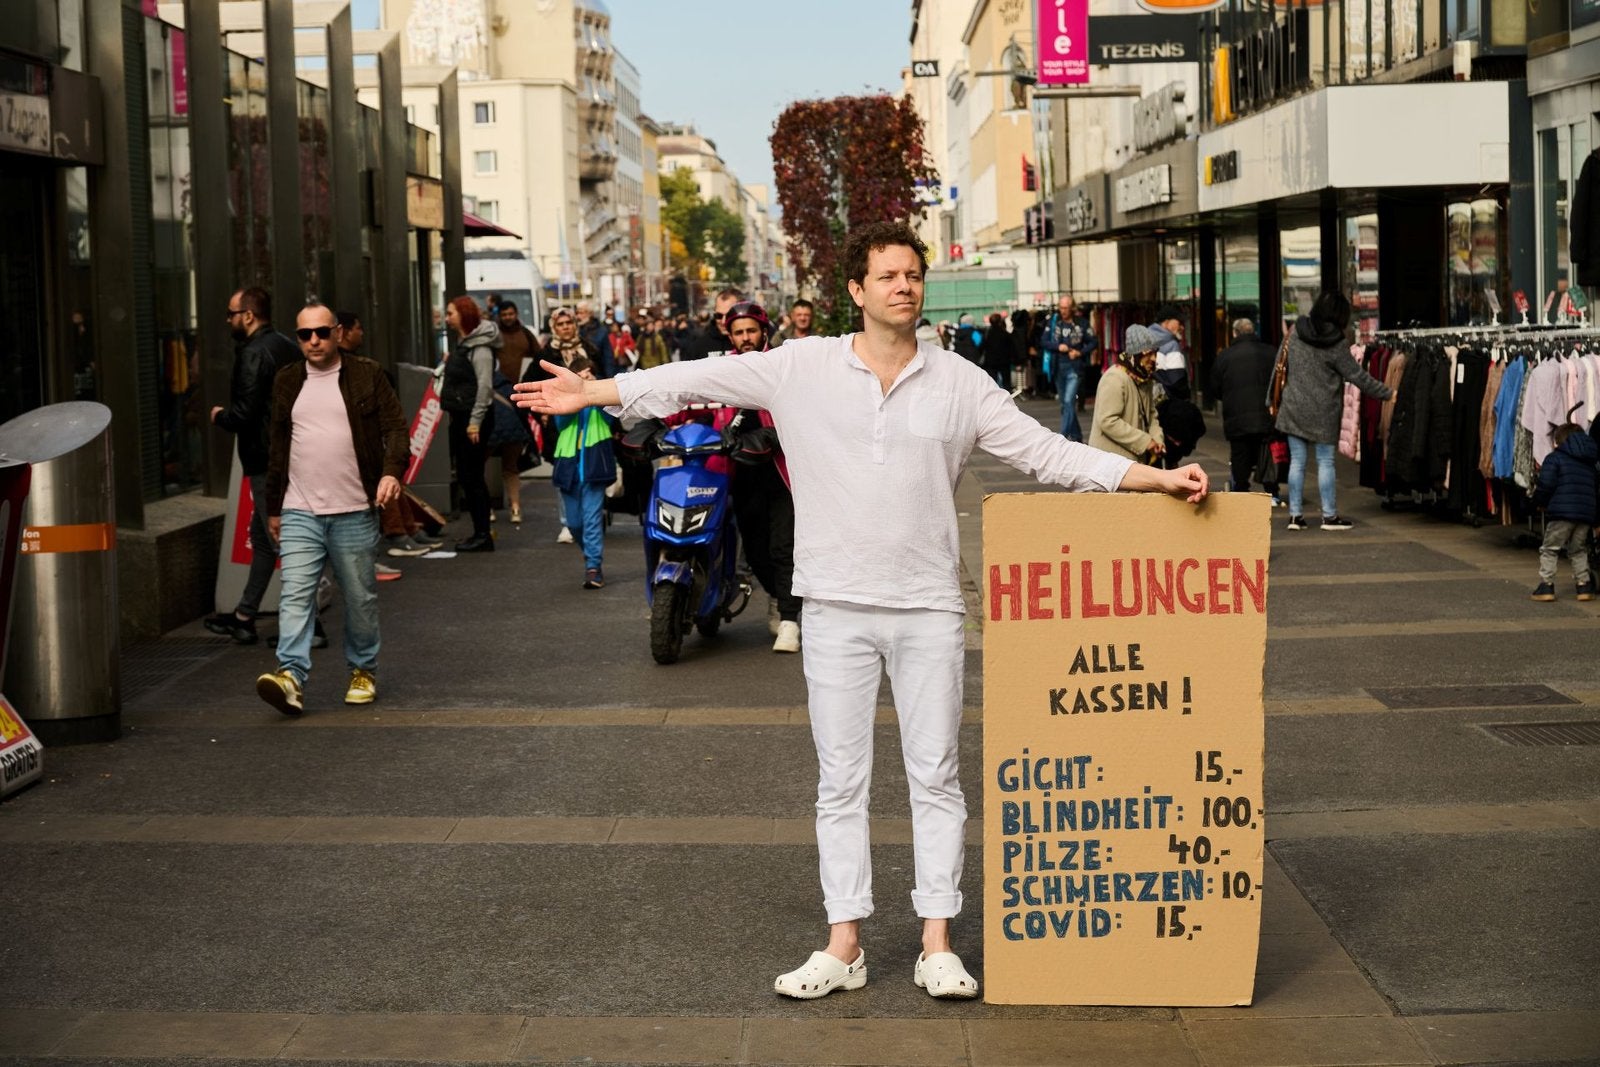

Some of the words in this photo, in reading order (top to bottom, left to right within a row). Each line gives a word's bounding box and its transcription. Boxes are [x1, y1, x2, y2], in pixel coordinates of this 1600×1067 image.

[1101, 41, 1185, 59] TEZENIS
[1043, 68, 1063, 76] YOUR
[1066, 68, 1086, 76] SHOP
[1068, 643, 1144, 675] ALLE
[1195, 750, 1243, 786] 15,-
[1168, 834, 1231, 865] 40,-
[1156, 905, 1202, 940] 15,-
